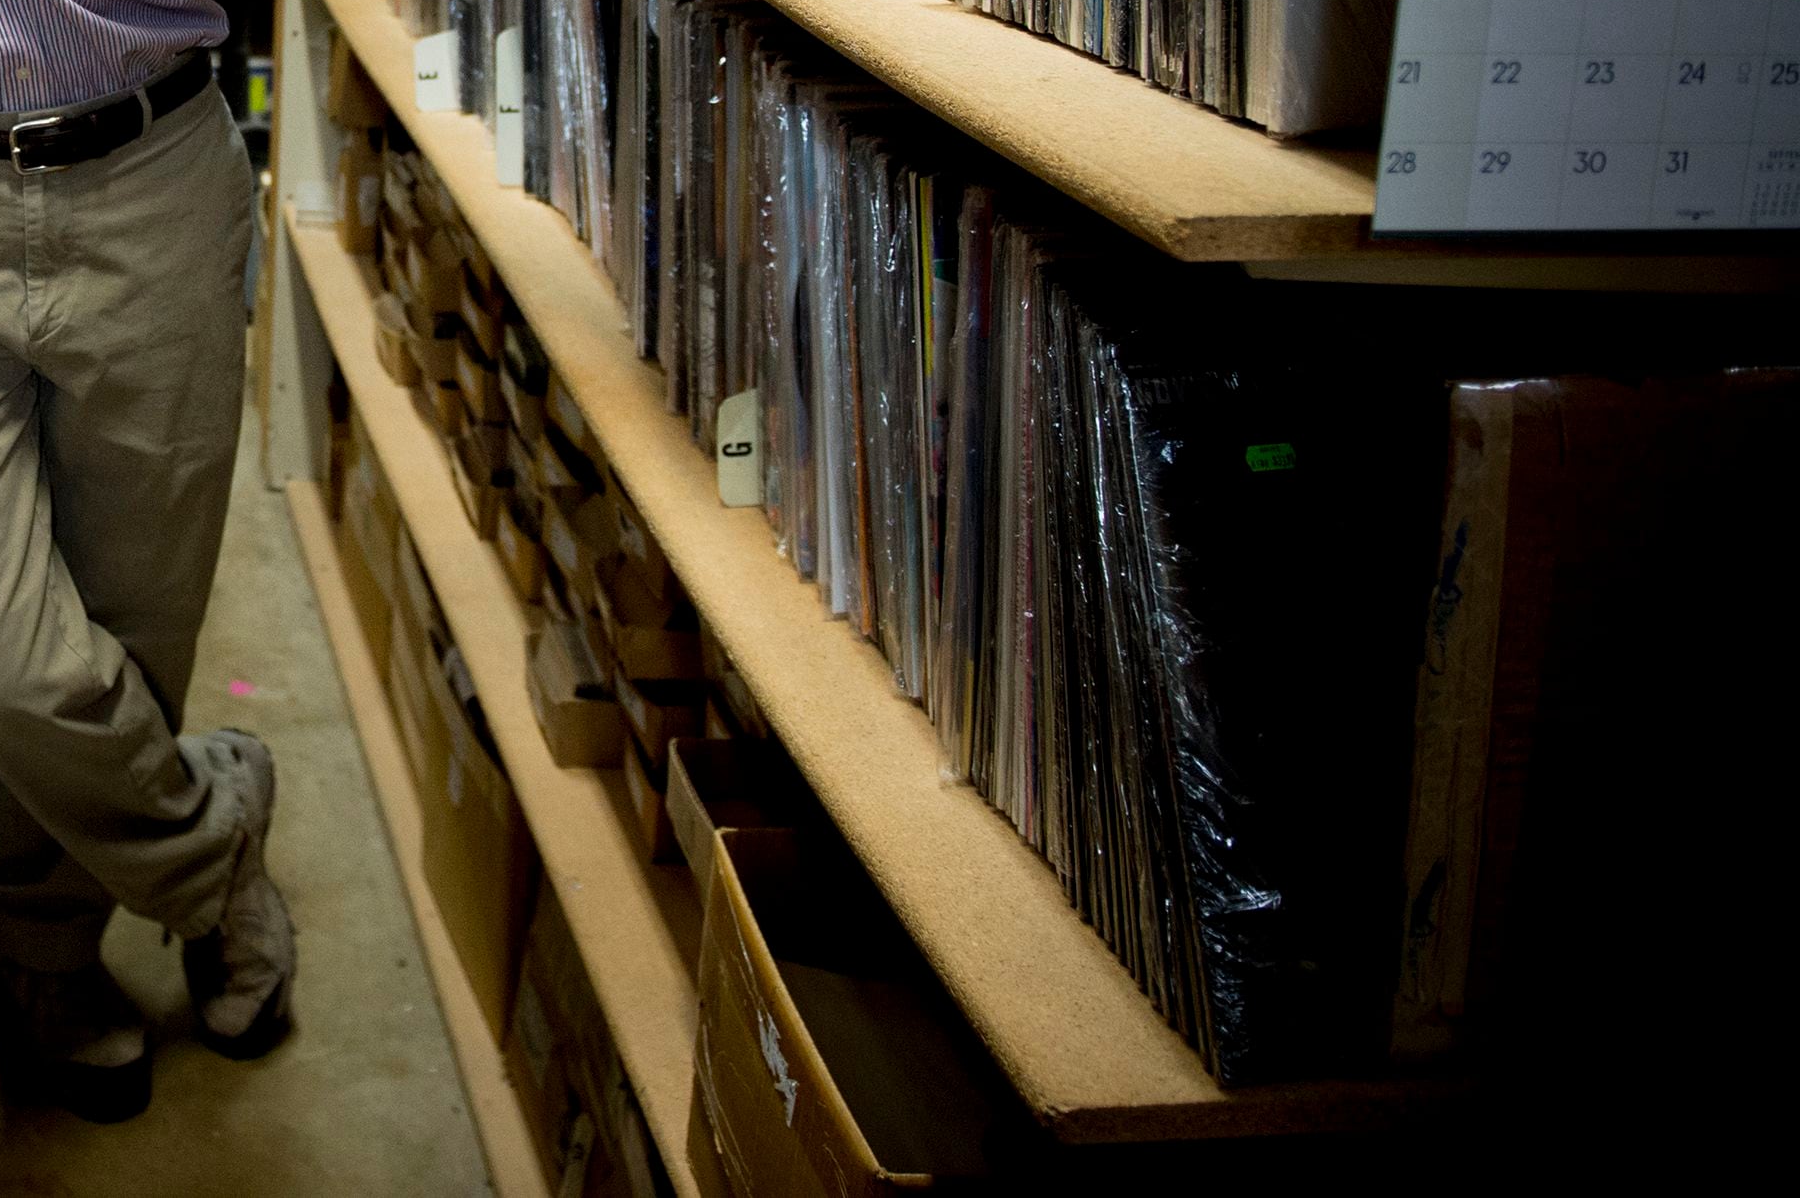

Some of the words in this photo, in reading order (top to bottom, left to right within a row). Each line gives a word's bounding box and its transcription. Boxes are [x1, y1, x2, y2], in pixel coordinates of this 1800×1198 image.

[418, 71, 438, 80] E
[1397, 62, 1421, 84] 21
[1491, 62, 1522, 84] 22
[1585, 62, 1616, 85] 23
[1678, 62, 1706, 85] 24
[1770, 63, 1800, 85] 25
[499, 104, 520, 113] F
[1386, 152, 1417, 174] 28
[1480, 152, 1511, 174] 29
[1573, 152, 1607, 174] 30
[1665, 152, 1689, 174] 31
[722, 441, 752, 457] G
